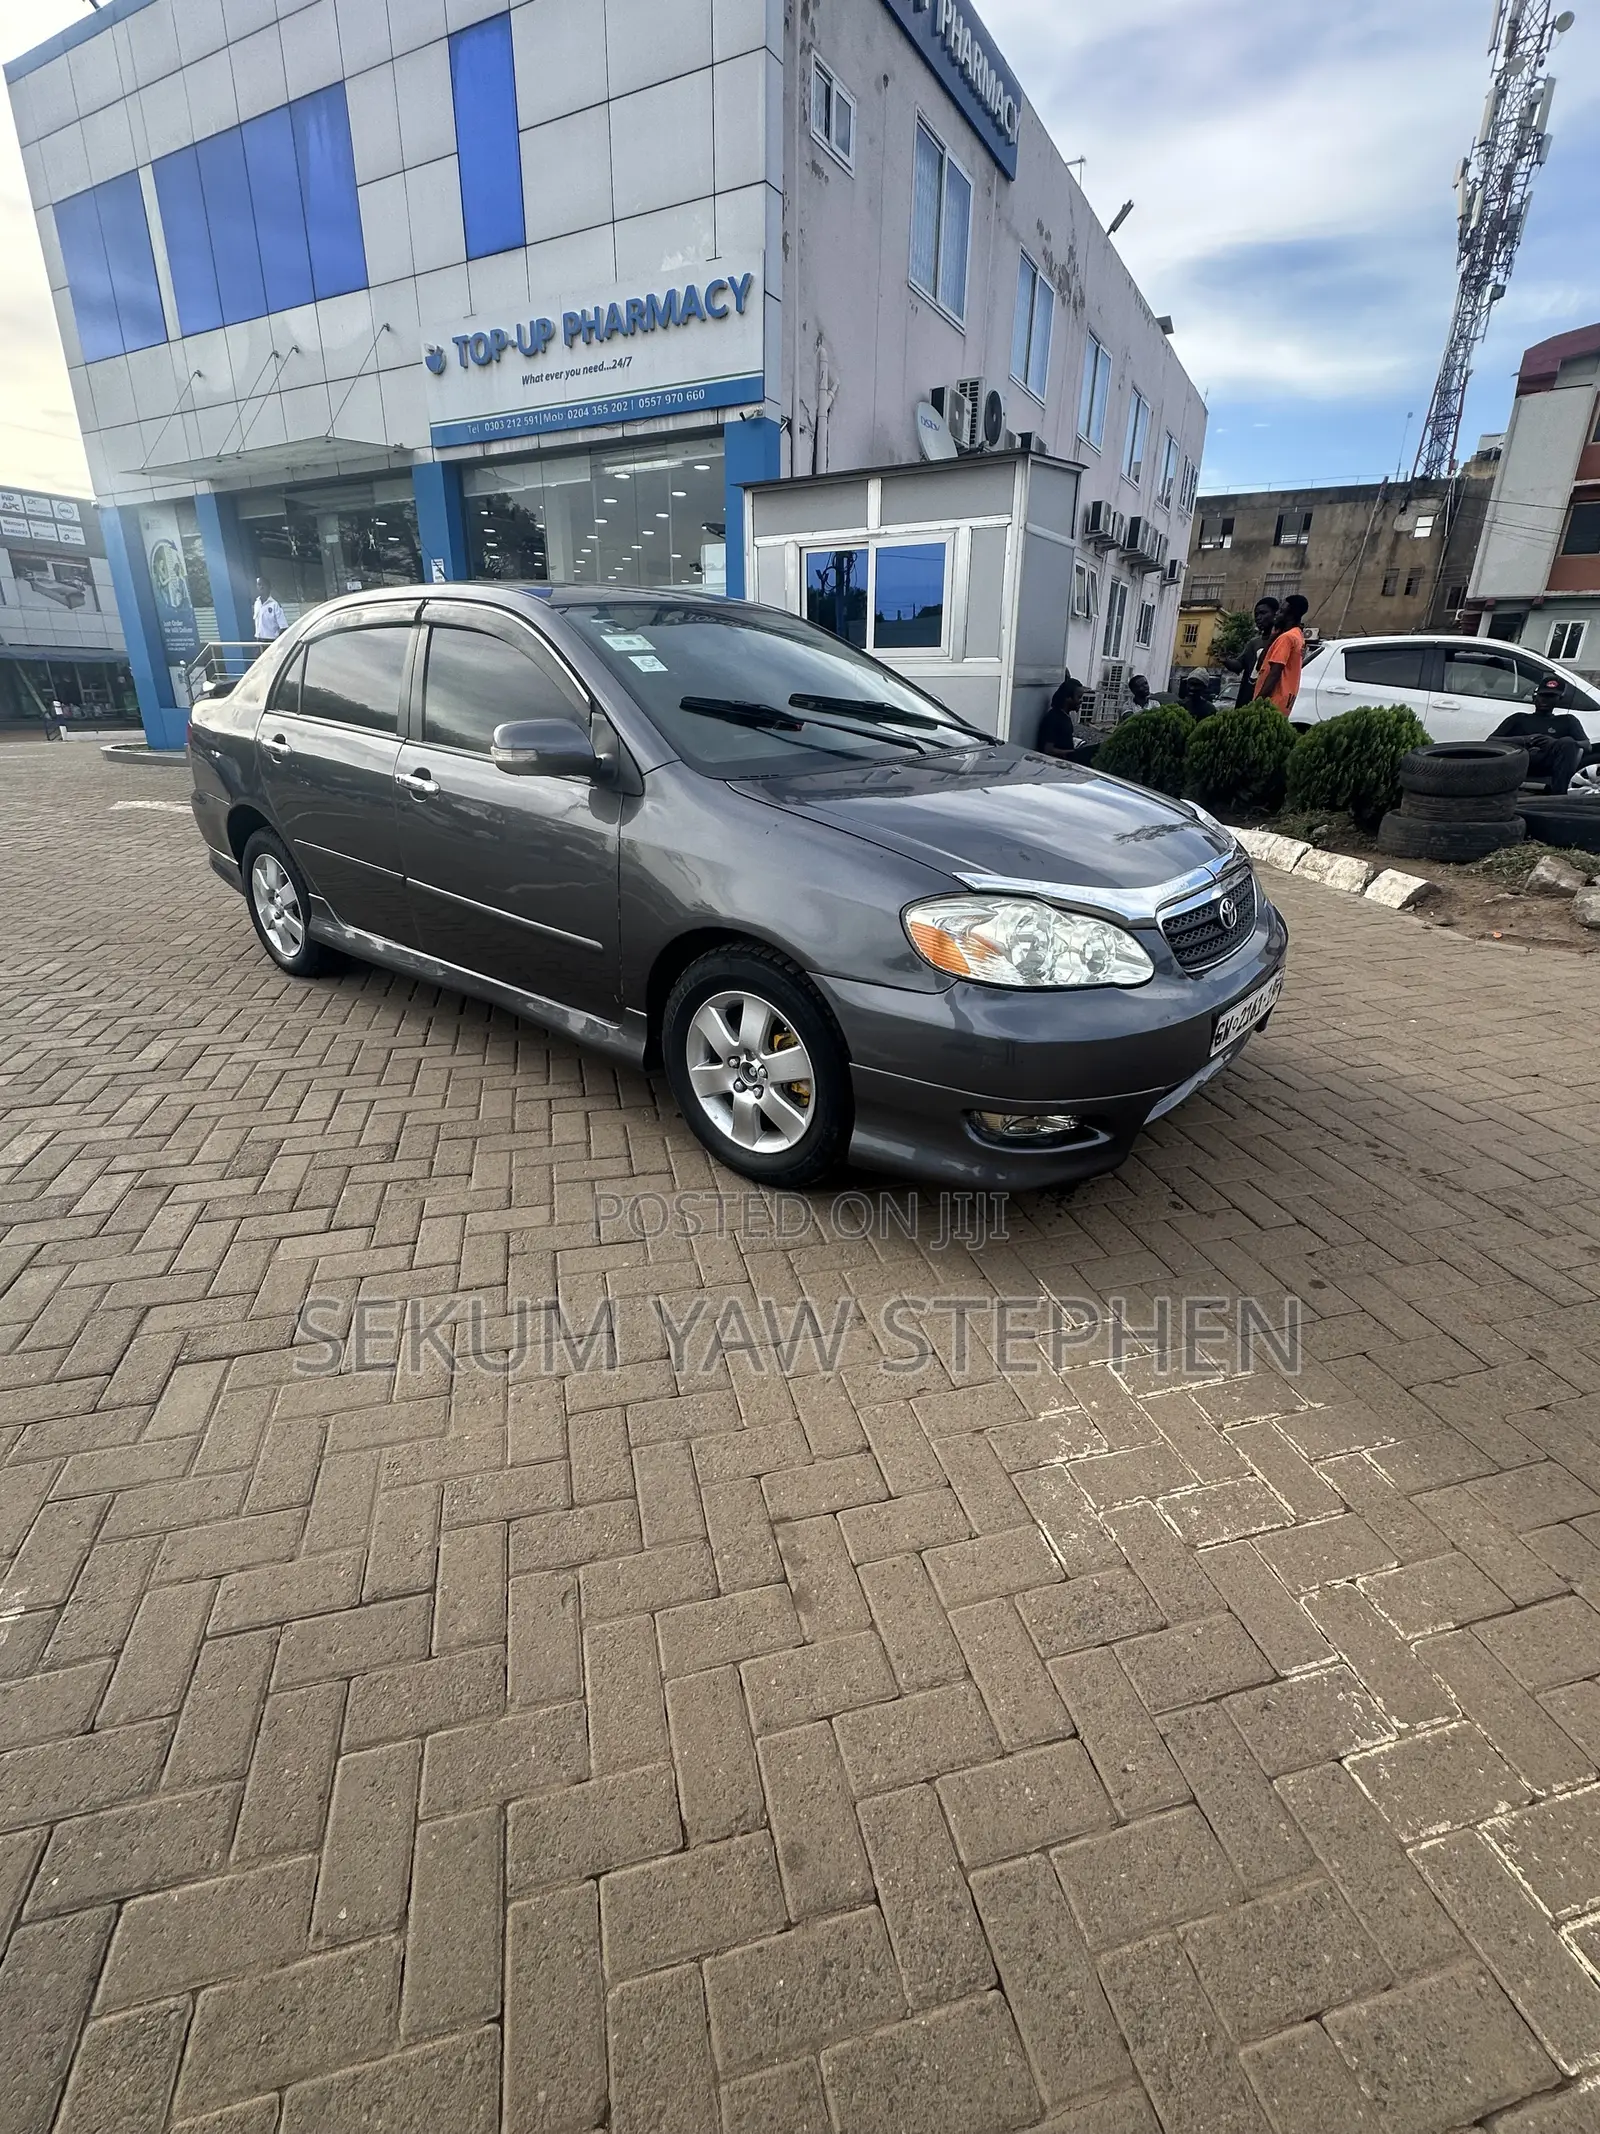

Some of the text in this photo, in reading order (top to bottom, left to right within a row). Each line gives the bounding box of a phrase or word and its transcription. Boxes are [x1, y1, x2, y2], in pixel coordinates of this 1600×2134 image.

[452, 272, 754, 369] TOP-UP PHARMACY
[521, 373, 544, 386] What
[545, 371, 564, 381] ever
[564, 368, 581, 380] you
[484, 419, 505, 432] 0303
[506, 417, 522, 429] 212
[567, 407, 589, 419] 0204
[592, 404, 609, 416] 355
[611, 401, 628, 413] 202
[638, 395, 662, 408] 0557
[664, 392, 684, 404] 970
[686, 388, 706, 401] 660
